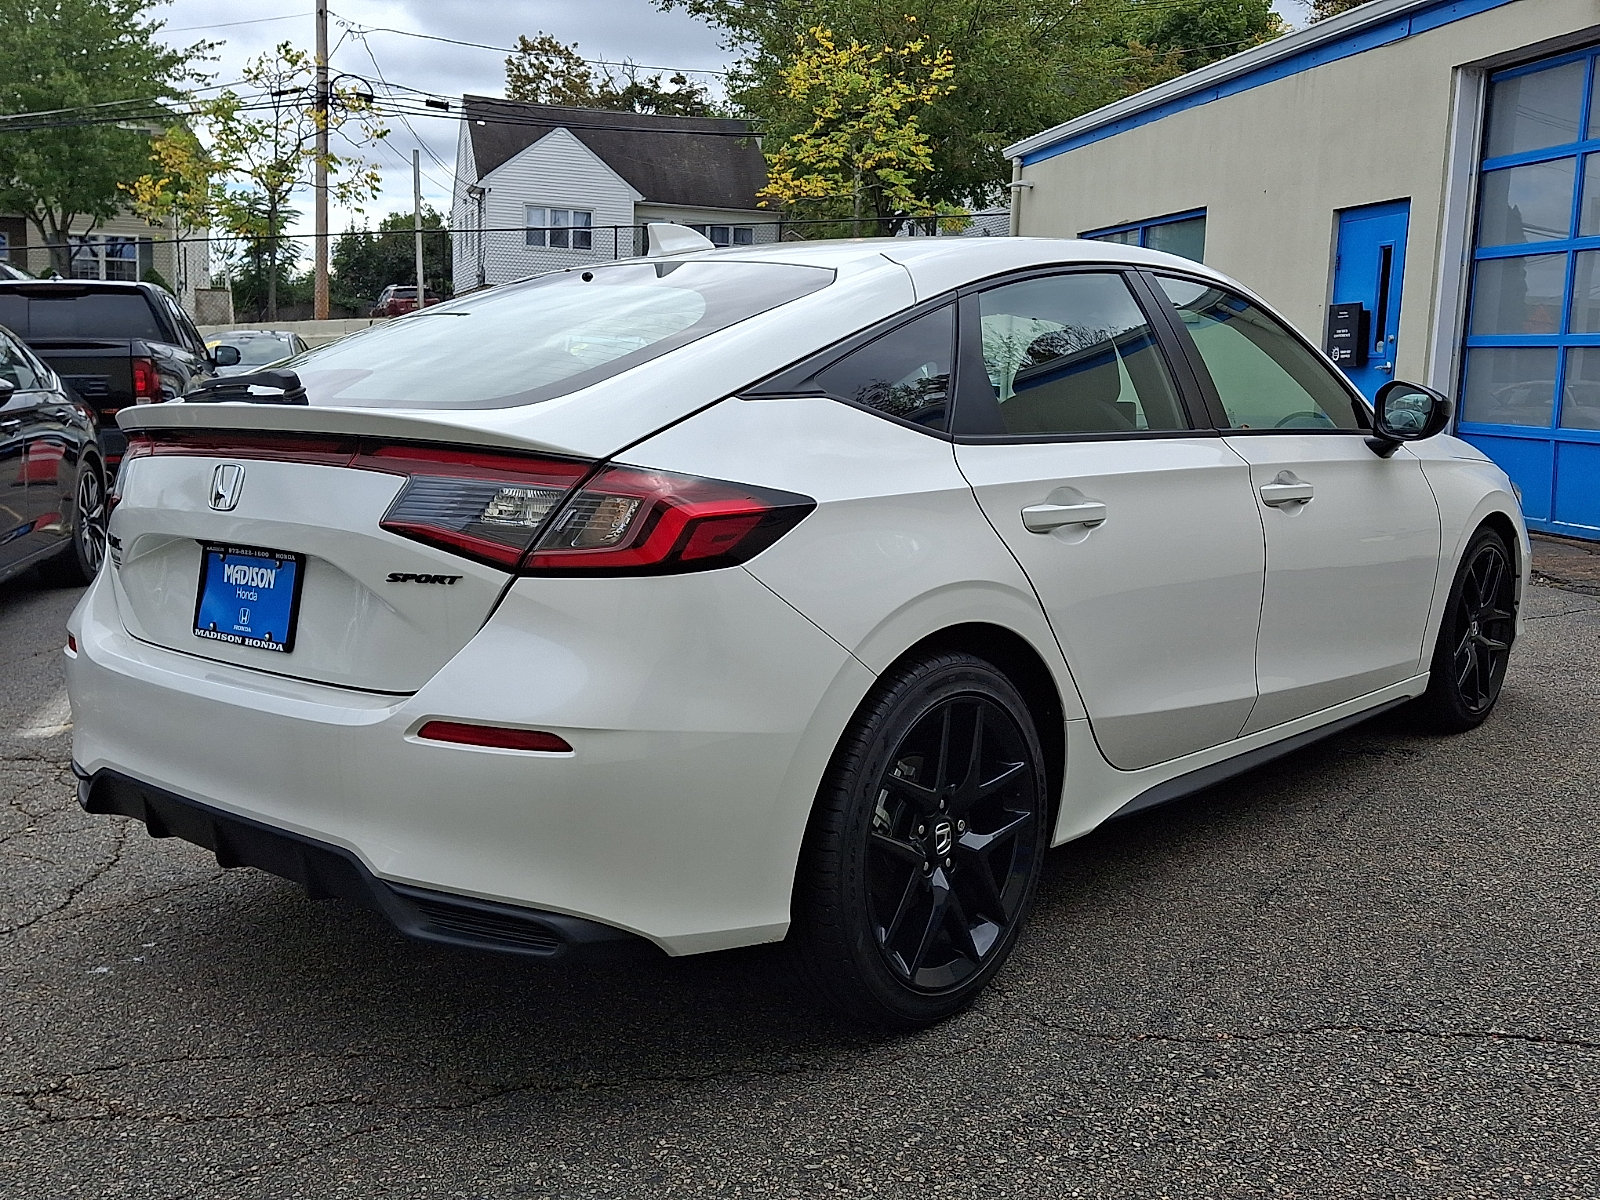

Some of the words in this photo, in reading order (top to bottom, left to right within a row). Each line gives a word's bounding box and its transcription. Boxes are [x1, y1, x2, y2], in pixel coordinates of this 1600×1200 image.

[275, 552, 296, 561] HONDA
[223, 563, 276, 589] MADISON
[385, 572, 464, 585] SPORT
[236, 587, 258, 602] Honda
[233, 624, 252, 633] HONDA
[194, 628, 243, 644] MADISON
[244, 637, 284, 652] HONDA
